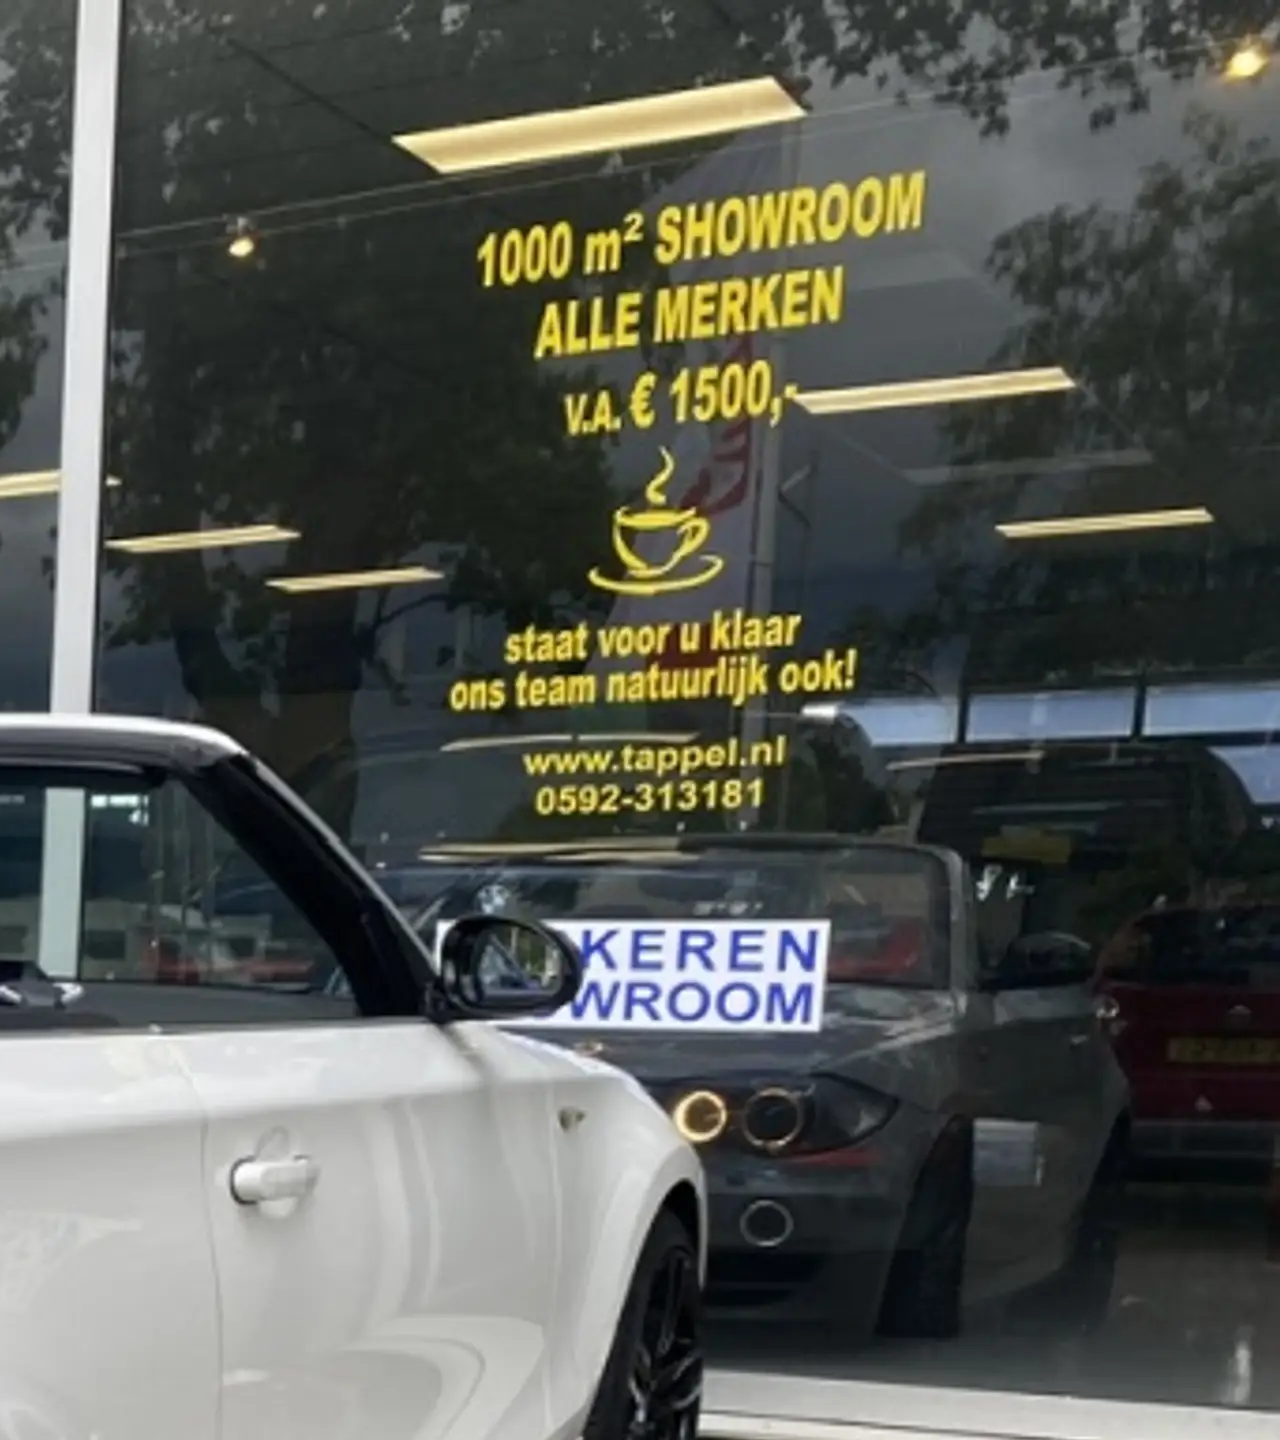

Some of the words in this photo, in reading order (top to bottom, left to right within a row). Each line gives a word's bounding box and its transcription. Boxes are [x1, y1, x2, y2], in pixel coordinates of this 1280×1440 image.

[476, 221, 573, 288] 1000
[654, 171, 926, 265] SHOWROOM
[534, 292, 641, 359] ALLE
[653, 265, 845, 342] MERKEN
[565, 393, 623, 436] V.A.
[670, 359, 800, 427] 1500,-
[505, 622, 589, 664] staat
[598, 622, 671, 658] voor
[680, 624, 700, 651] u
[710, 611, 802, 650] klaar
[450, 679, 506, 712] ons
[515, 671, 598, 709] team
[605, 656, 769, 706] natuurlijk
[779, 650, 858, 692] ook!
[524, 736, 788, 777] www.tappel.nl
[535, 778, 765, 816] 0592-313181
[580, 927, 820, 975] KEREN
[568, 980, 815, 1024] WROOM
